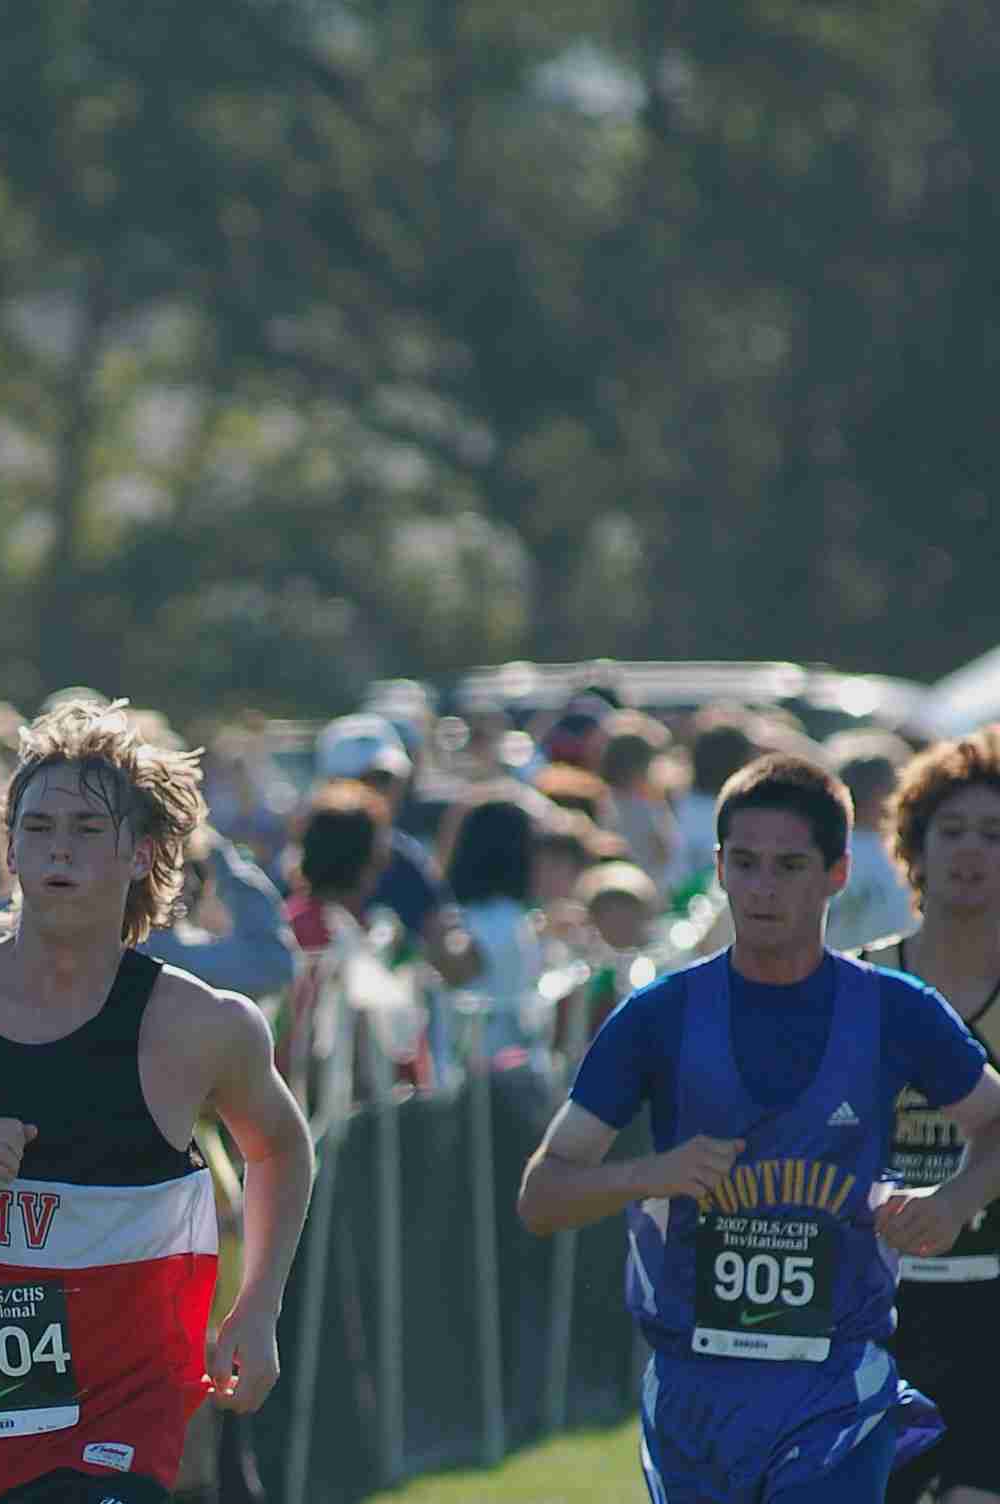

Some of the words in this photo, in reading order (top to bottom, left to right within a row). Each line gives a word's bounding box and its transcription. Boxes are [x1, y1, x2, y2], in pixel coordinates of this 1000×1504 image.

[716, 1216, 749, 1232] 2007
[750, 1219, 819, 1237] DLS/CHS
[724, 1231, 809, 1250] Invitational
[713, 1251, 816, 1307] 905
